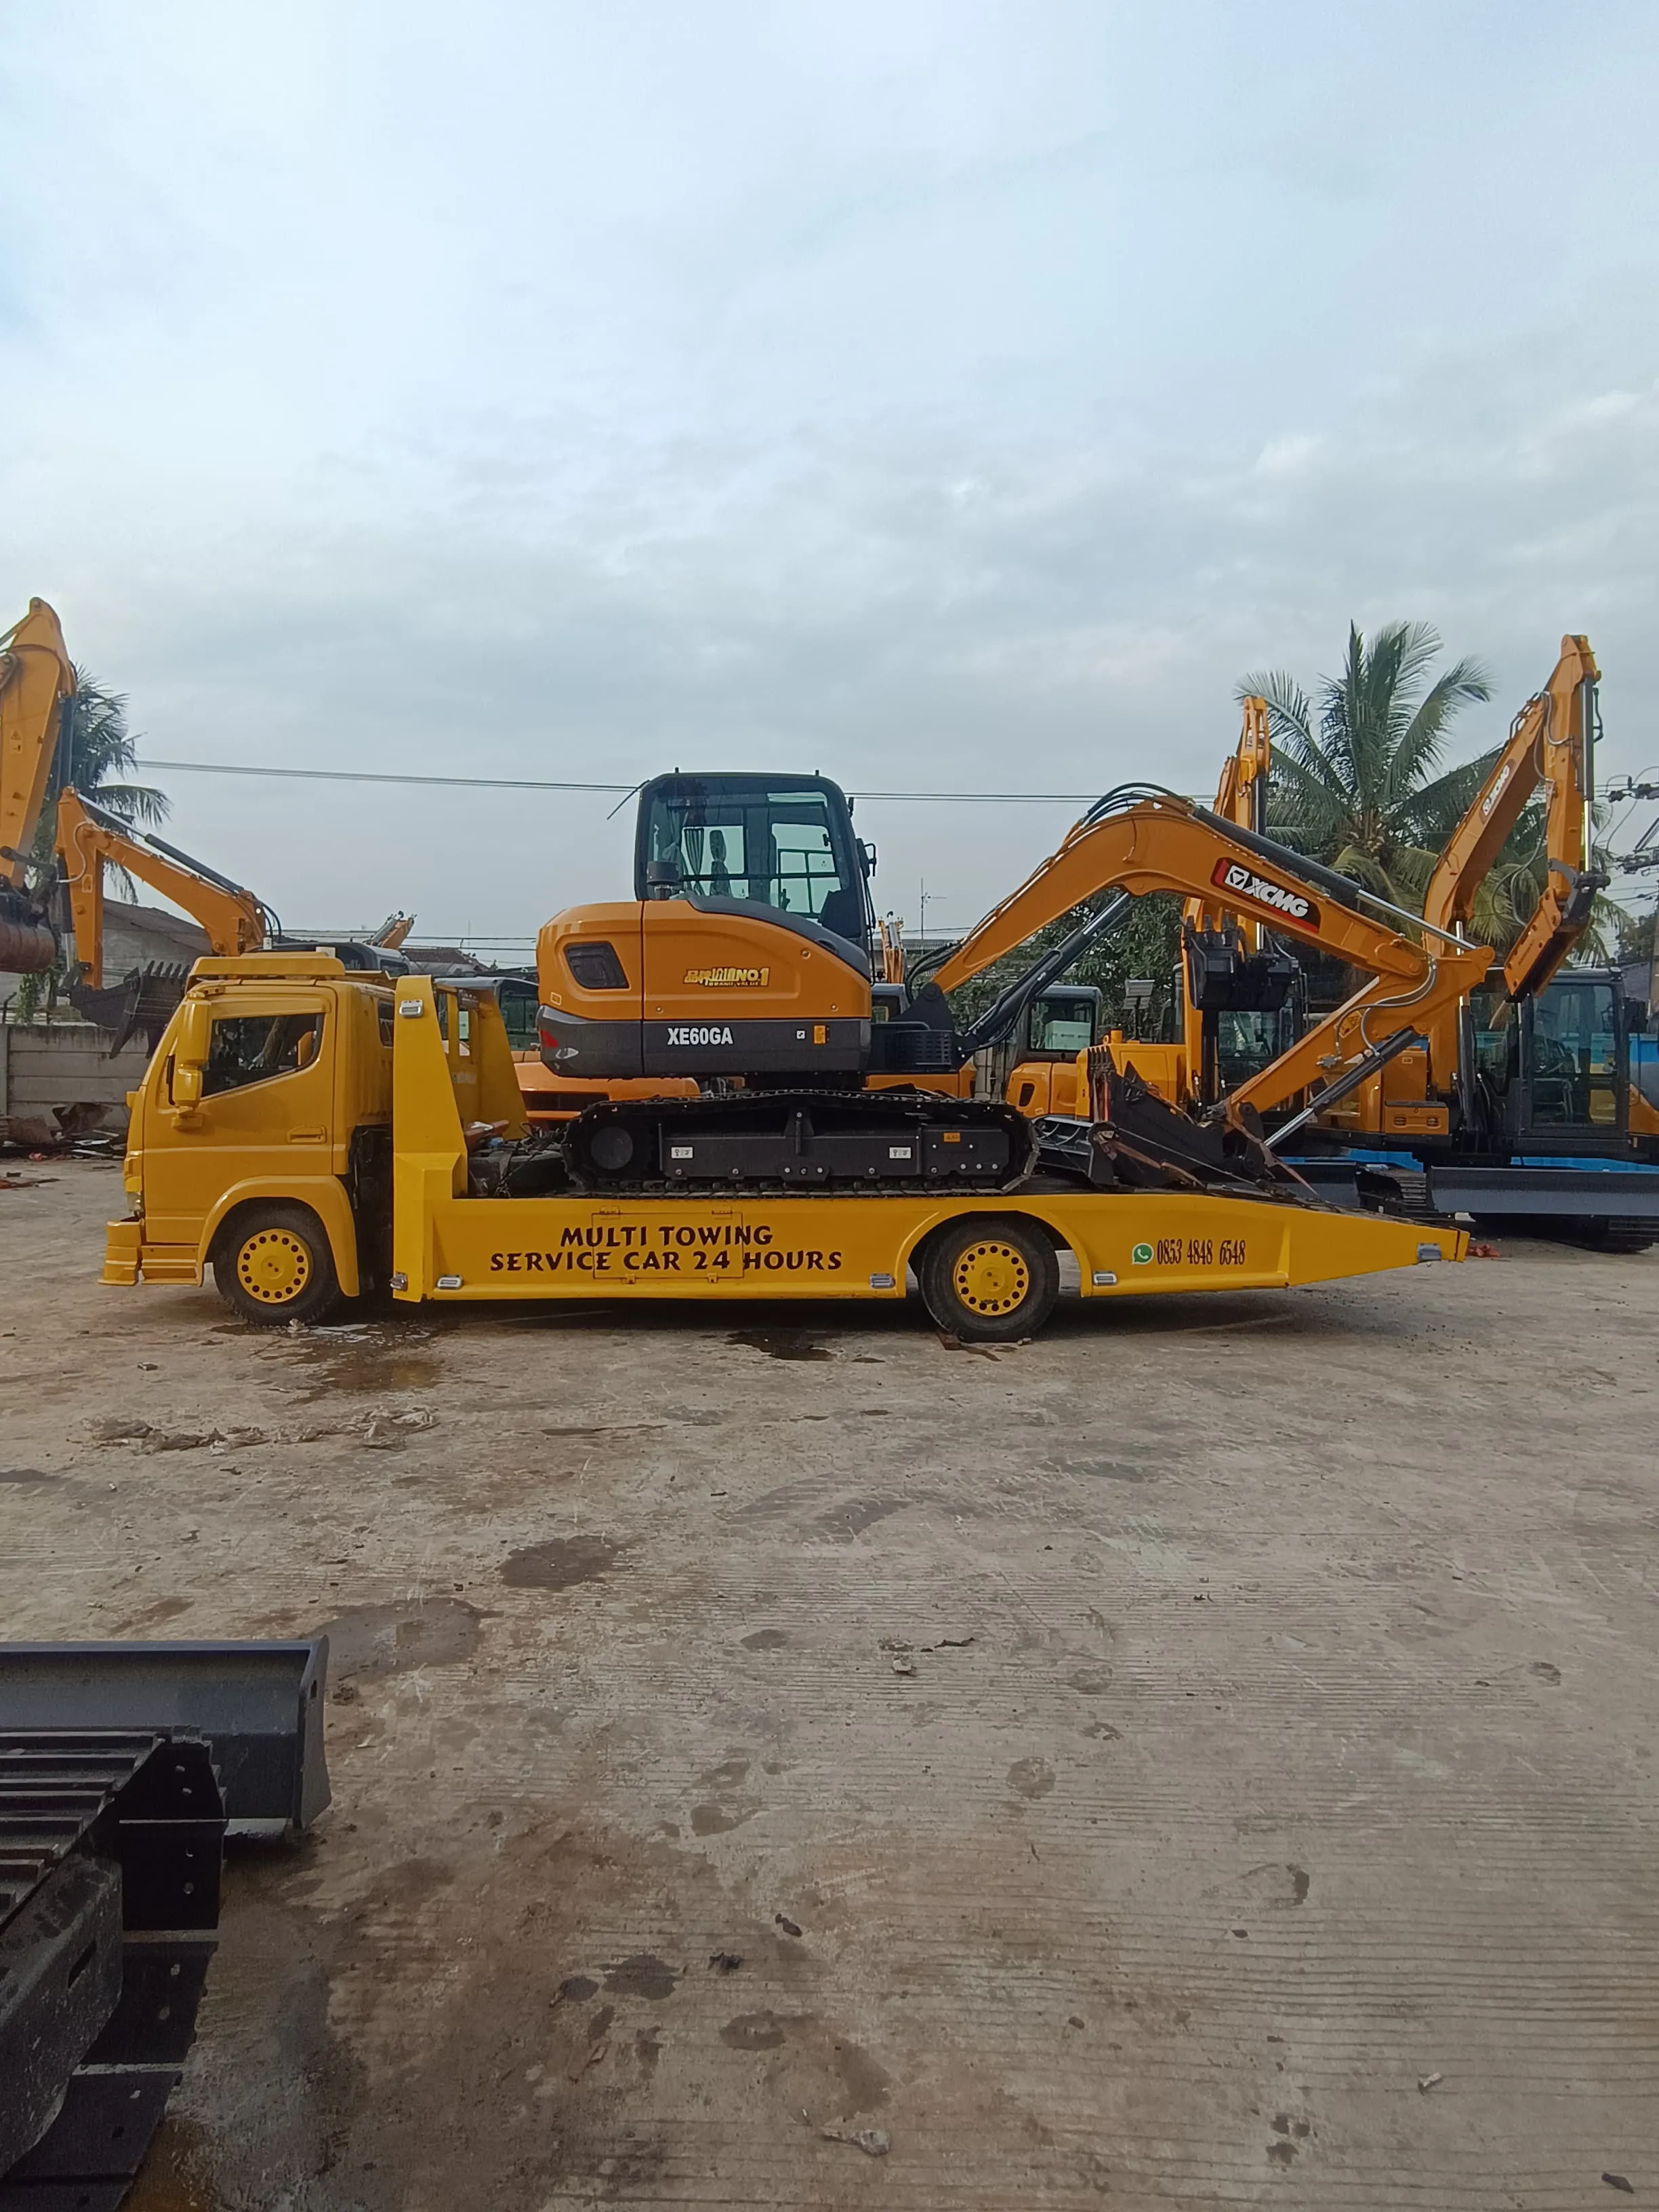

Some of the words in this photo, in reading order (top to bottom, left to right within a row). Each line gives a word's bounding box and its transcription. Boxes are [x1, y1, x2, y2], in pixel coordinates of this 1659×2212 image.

[1242, 876, 1309, 917] XCMG
[667, 1027, 733, 1045] XE60GA
[560, 1226, 647, 1248] MULTI
[659, 1225, 773, 1246] TOWING
[490, 1252, 612, 1271] SERVICE
[623, 1251, 681, 1271] CAR
[693, 1250, 731, 1269] 24
[743, 1250, 842, 1270] HOURS
[1157, 1238, 1183, 1265] 0853
[1187, 1239, 1213, 1265] 4848
[1219, 1240, 1246, 1265] 6548
